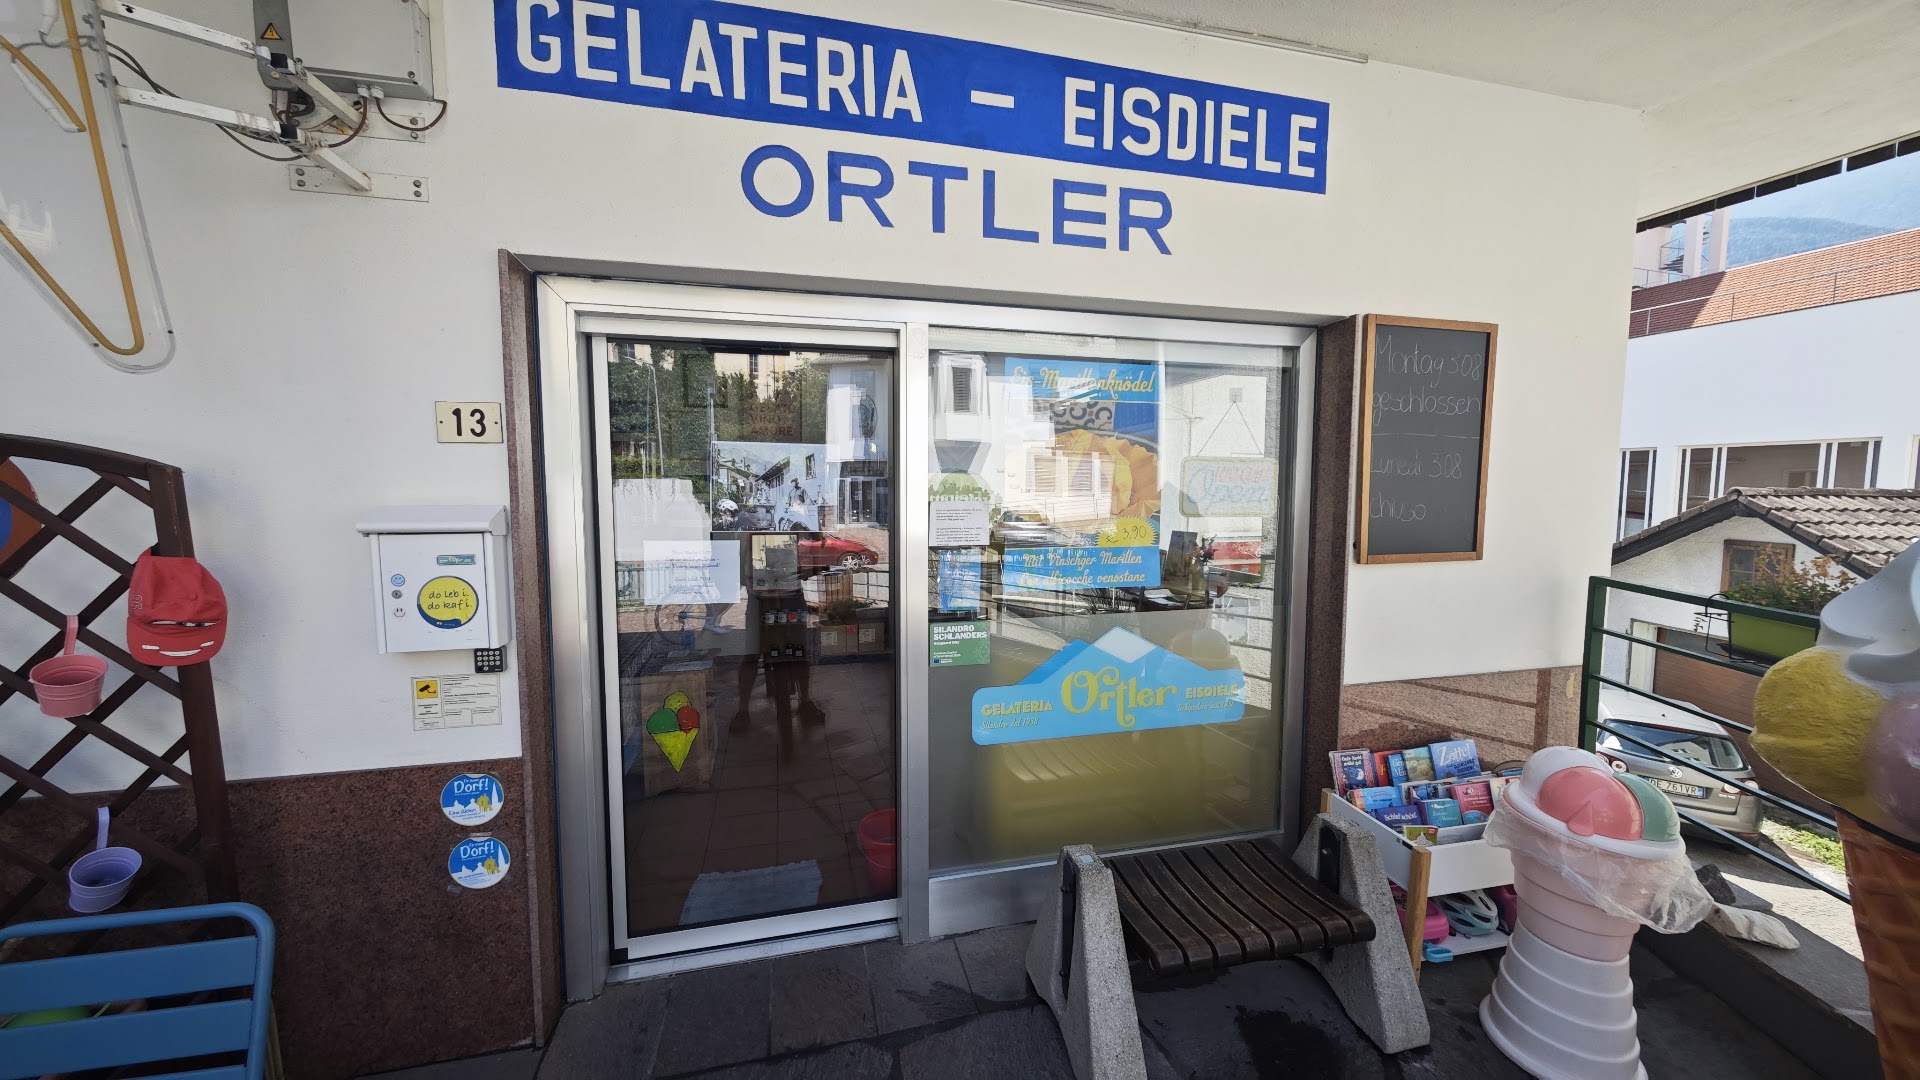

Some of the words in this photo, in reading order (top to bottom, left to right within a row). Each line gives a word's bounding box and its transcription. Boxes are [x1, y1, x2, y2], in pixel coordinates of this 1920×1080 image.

[516, 0, 922, 122] GELATERIA
[1064, 76, 1318, 178] EISDIELE
[741, 144, 1173, 255] ORTLER
[1372, 386, 1481, 427] geschlossen
[452, 408, 487, 437] 13
[1370, 491, 1427, 521] chiuso
[1100, 550, 1142, 565] Marillen
[1097, 571, 1146, 584] venostane
[429, 591, 442, 600] do
[427, 601, 441, 610] do
[933, 625, 975, 634] SILANDRO
[933, 631, 988, 641] SCHLANDERS
[1061, 665, 1178, 728] Ortler
[1186, 683, 1239, 700] EISDIELE
[981, 700, 1054, 717] GELATERIA
[1437, 743, 1472, 766] Zottel
[453, 778, 489, 794] Dorf!
[460, 841, 495, 859] Dorf!
